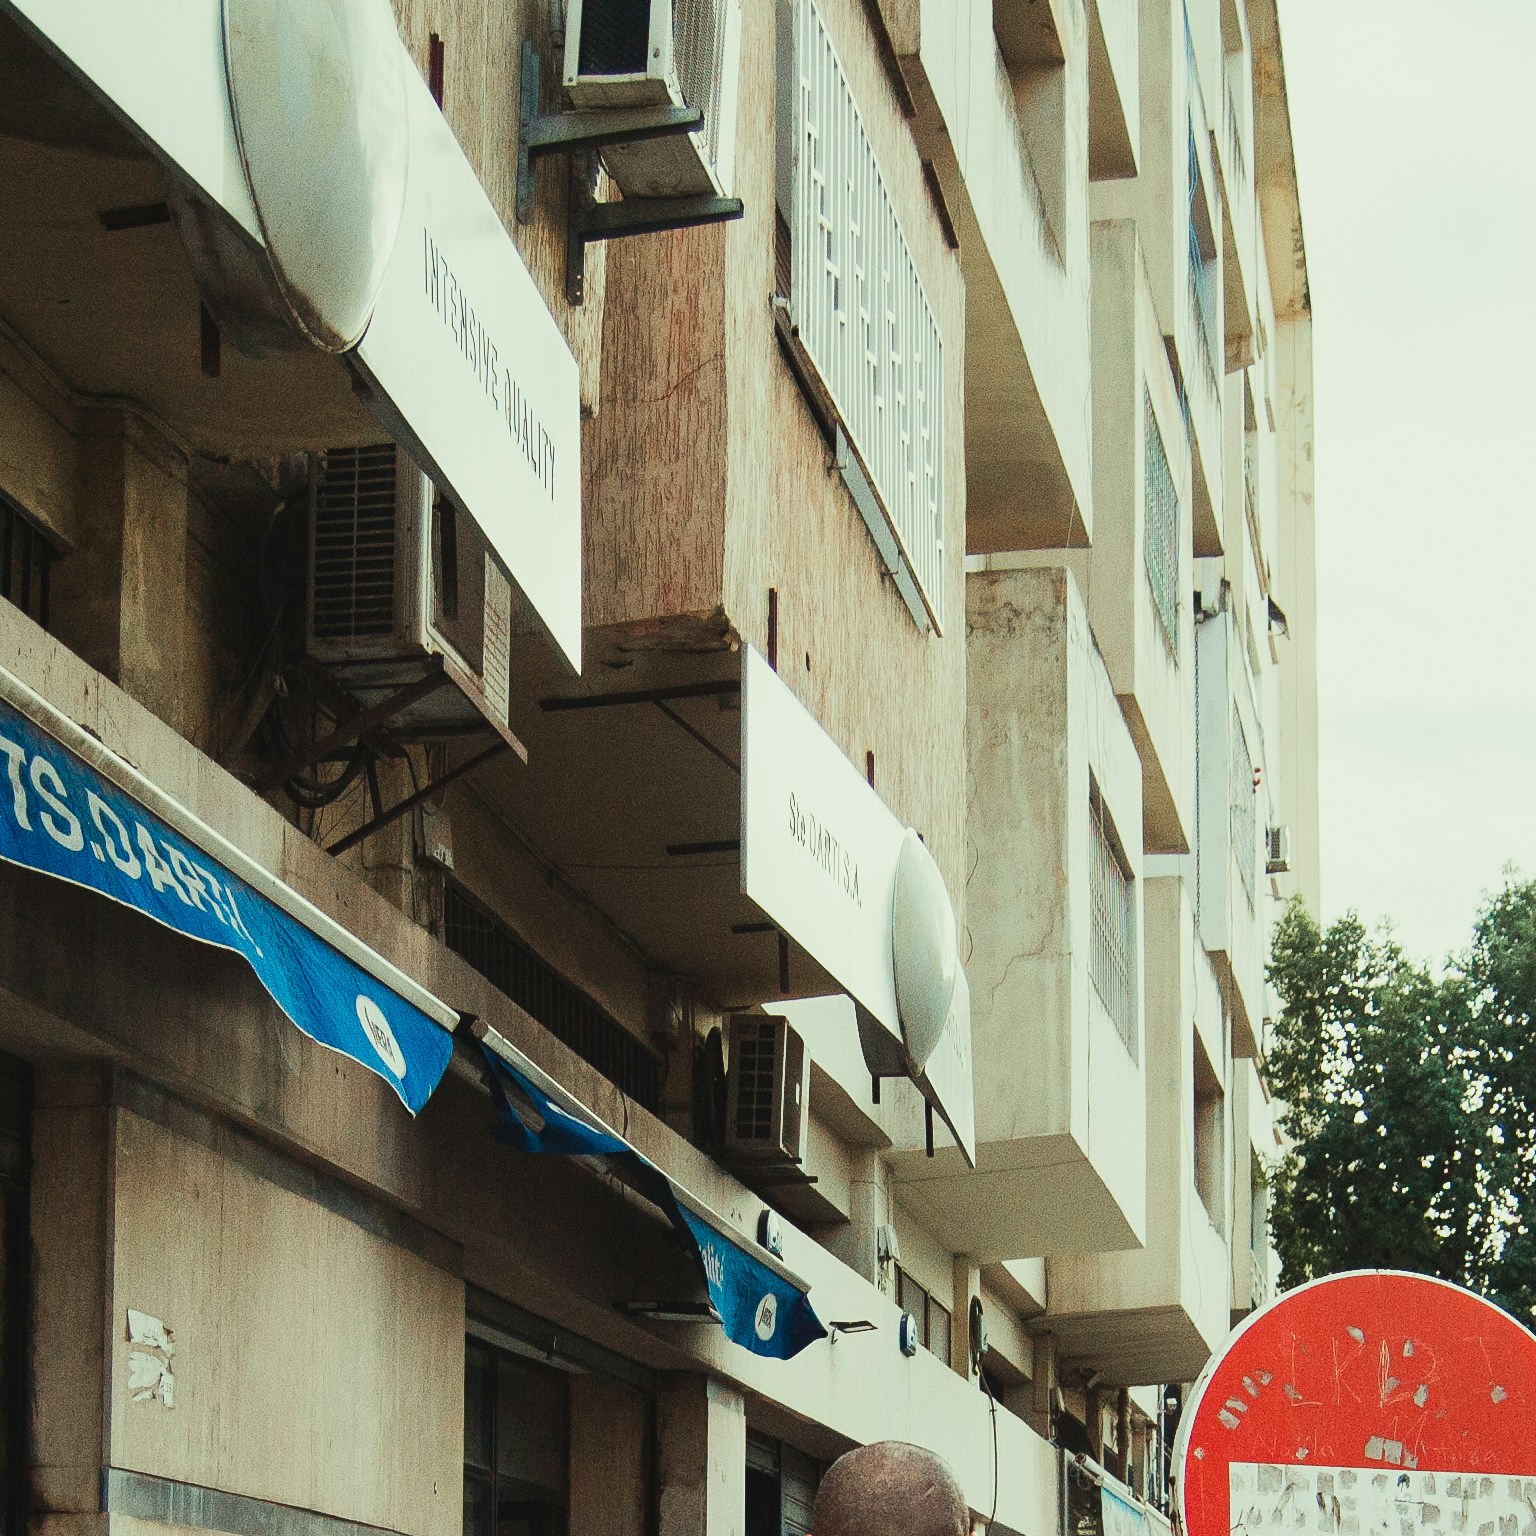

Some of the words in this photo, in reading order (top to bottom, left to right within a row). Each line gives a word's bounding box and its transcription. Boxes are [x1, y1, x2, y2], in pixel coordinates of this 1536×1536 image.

[423, 226, 499, 412] INTENSIVE
[504, 367, 556, 502] QUALITY
[809, 812, 841, 885] DARTI
